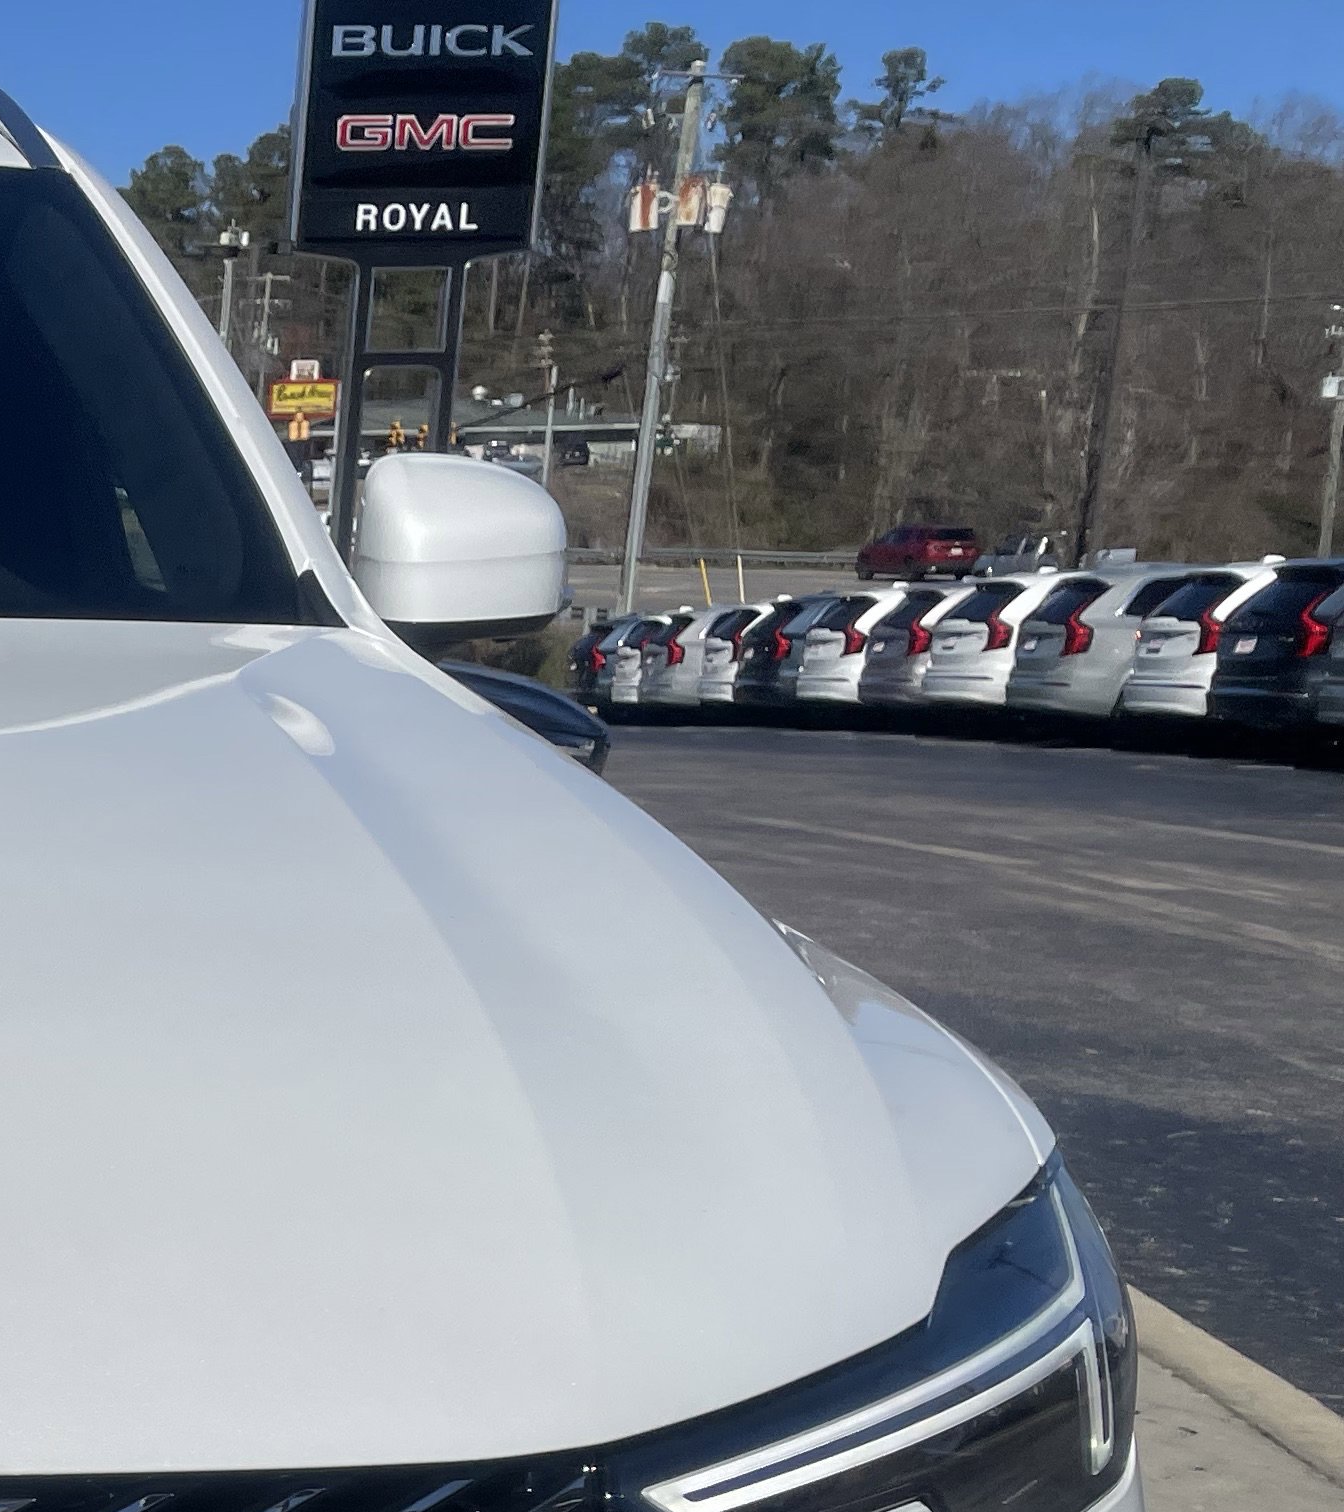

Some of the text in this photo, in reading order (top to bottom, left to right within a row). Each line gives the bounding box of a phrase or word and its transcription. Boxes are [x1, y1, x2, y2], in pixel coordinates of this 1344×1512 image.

[331, 24, 534, 57] BUICK
[337, 113, 515, 151] GMC
[355, 203, 478, 231] ROYAL
